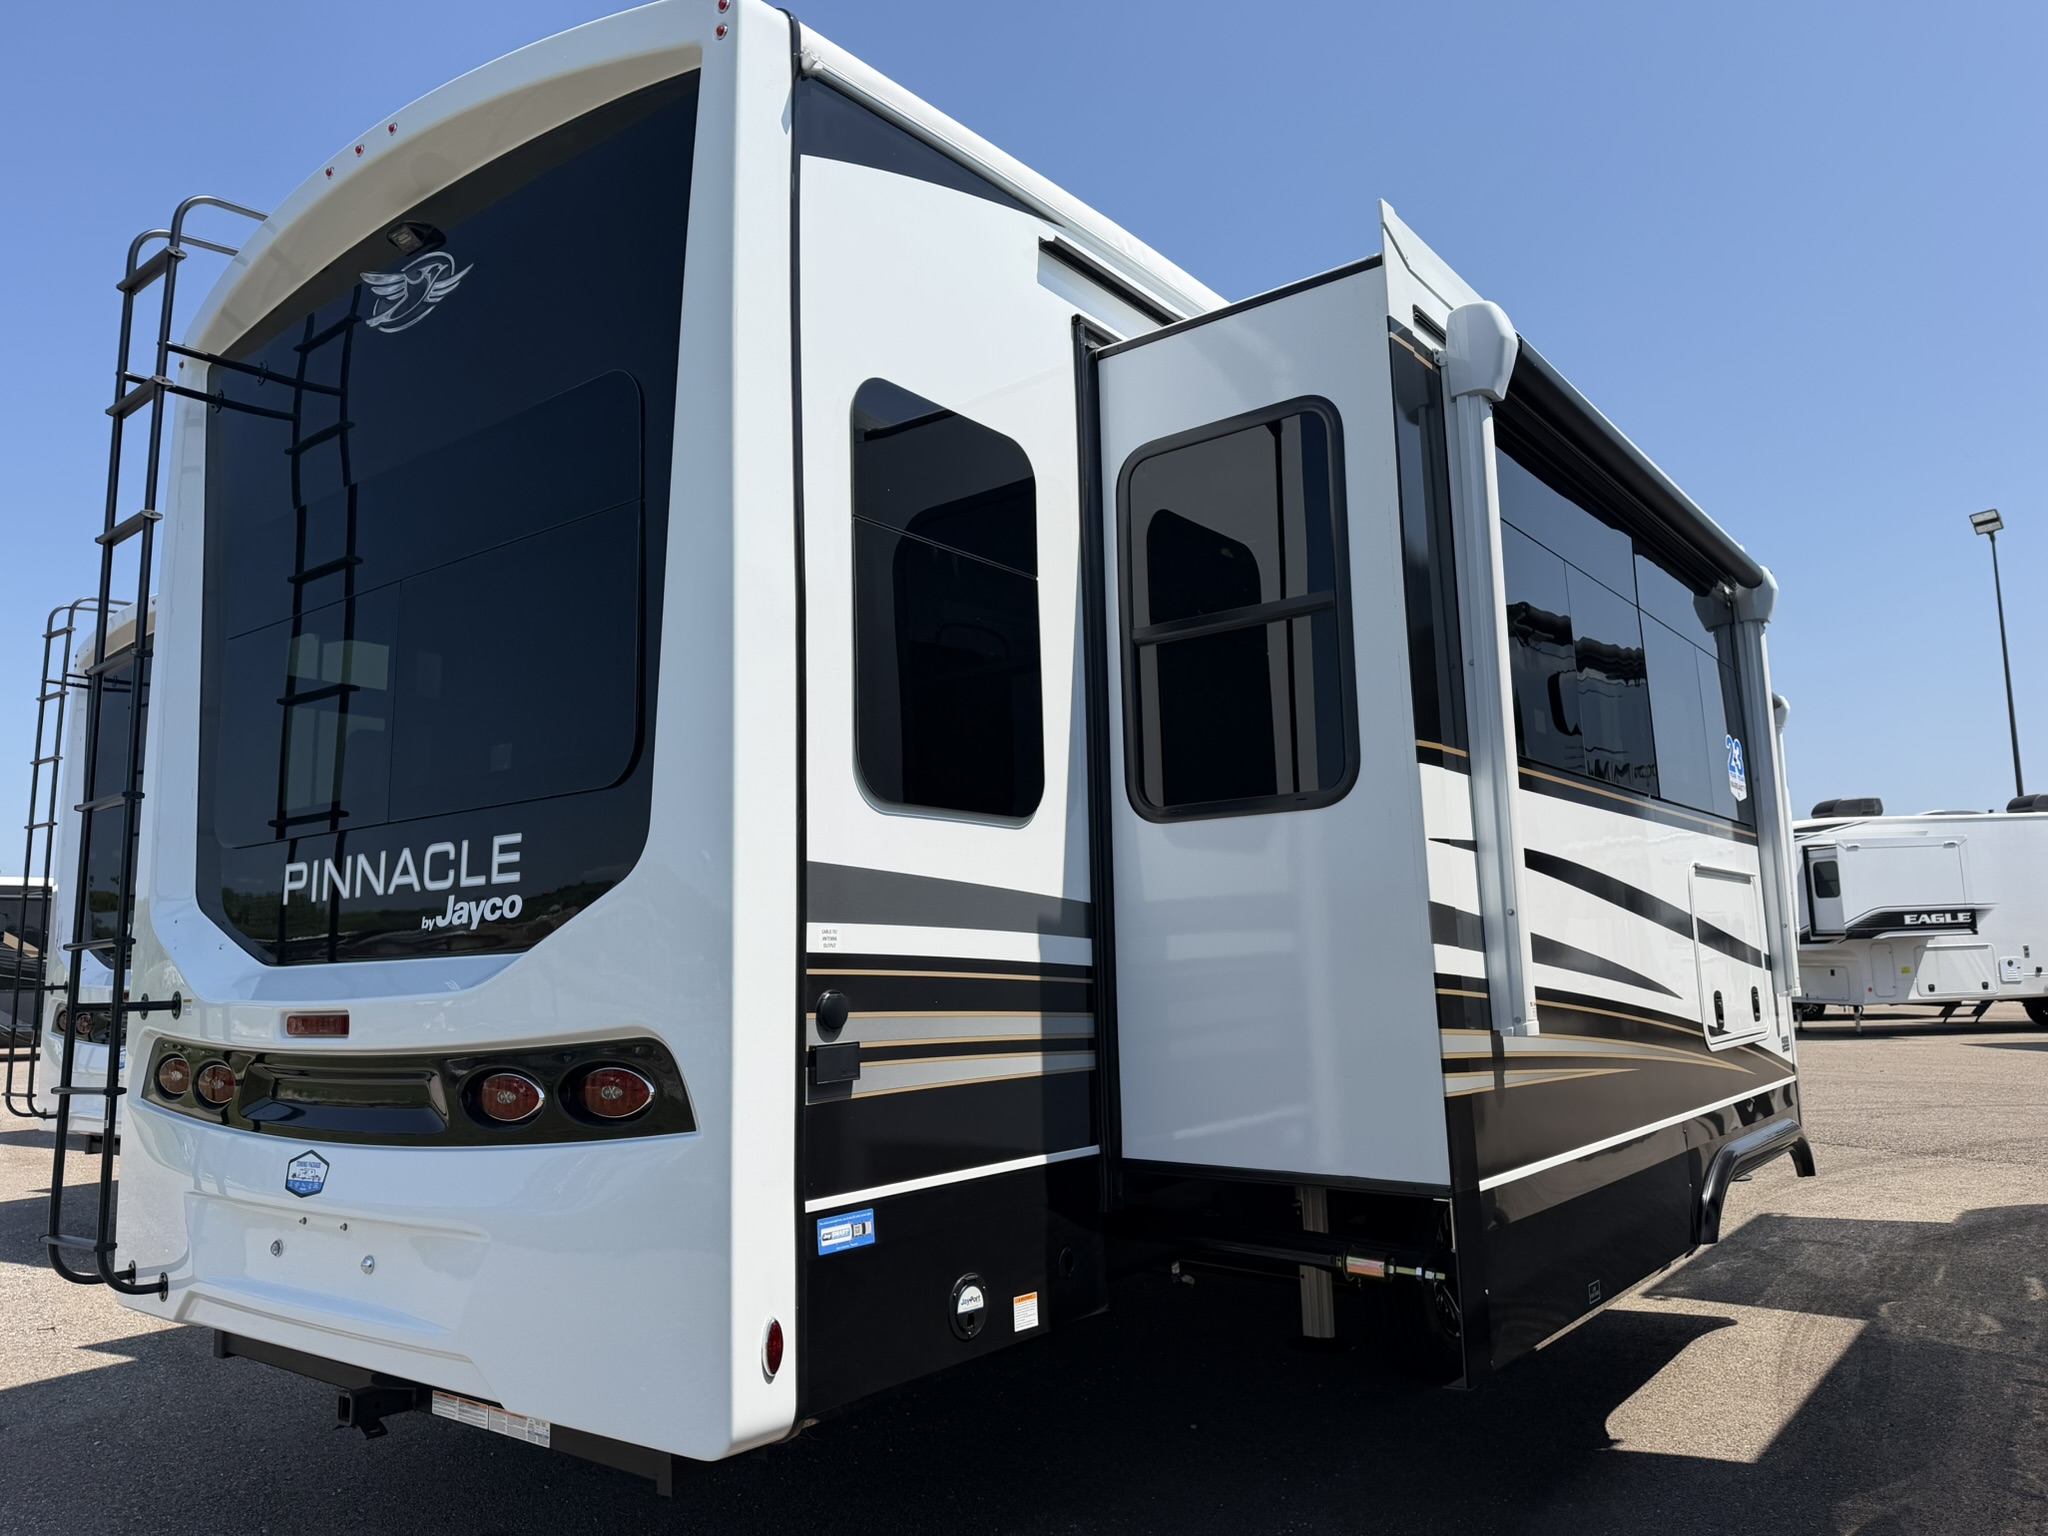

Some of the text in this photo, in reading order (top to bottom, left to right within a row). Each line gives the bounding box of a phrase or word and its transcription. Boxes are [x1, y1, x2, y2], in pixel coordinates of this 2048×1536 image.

[282, 832, 522, 906] PINNACLE
[421, 894, 523, 932] by Jayco
[1903, 912, 1972, 925] EAGLE
